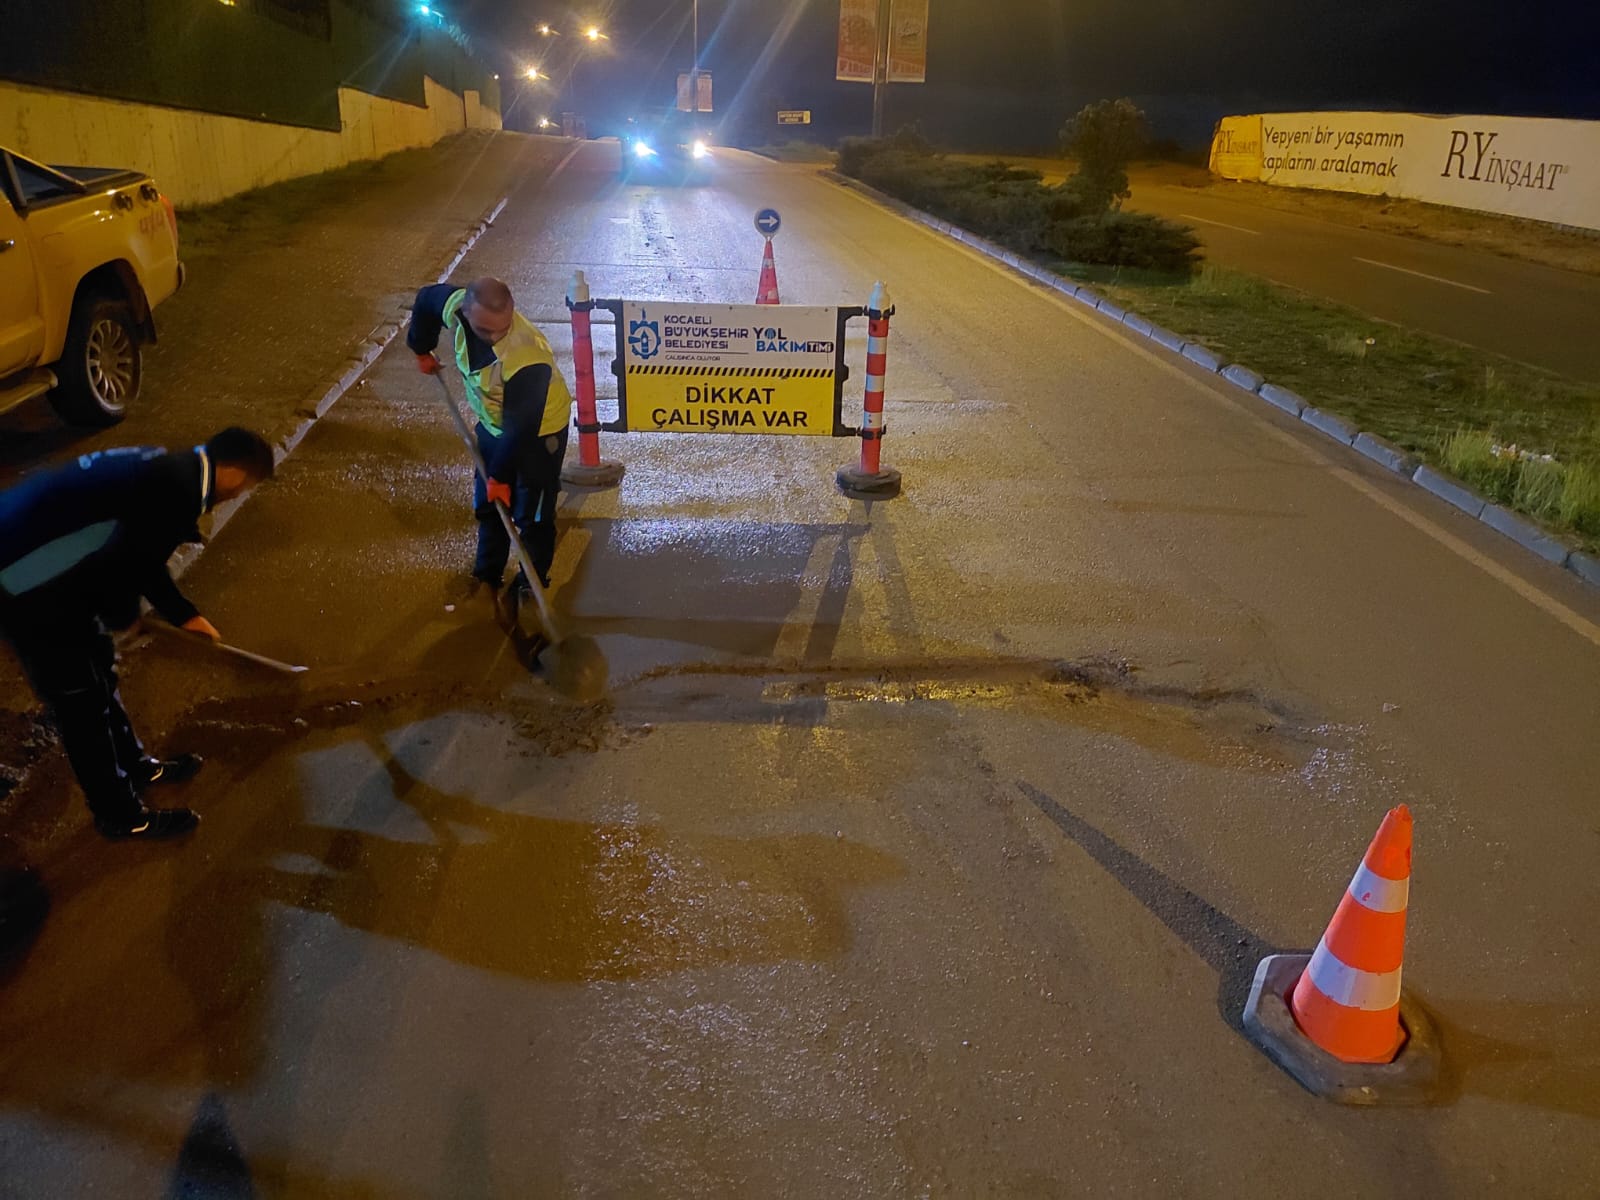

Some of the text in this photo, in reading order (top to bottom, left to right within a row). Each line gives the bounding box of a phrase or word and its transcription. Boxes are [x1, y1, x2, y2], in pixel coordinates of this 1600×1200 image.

[1264, 126, 1404, 150] Yepyeni bir yaşamın
[1320, 154, 1398, 177] aralamak
[1441, 130, 1564, 191] RY İNŞAAT
[664, 326, 749, 339] BÜYÜKŞEHİR
[686, 382, 775, 405] DİKKAT
[652, 408, 808, 430] ÇALIŞMA VAR
